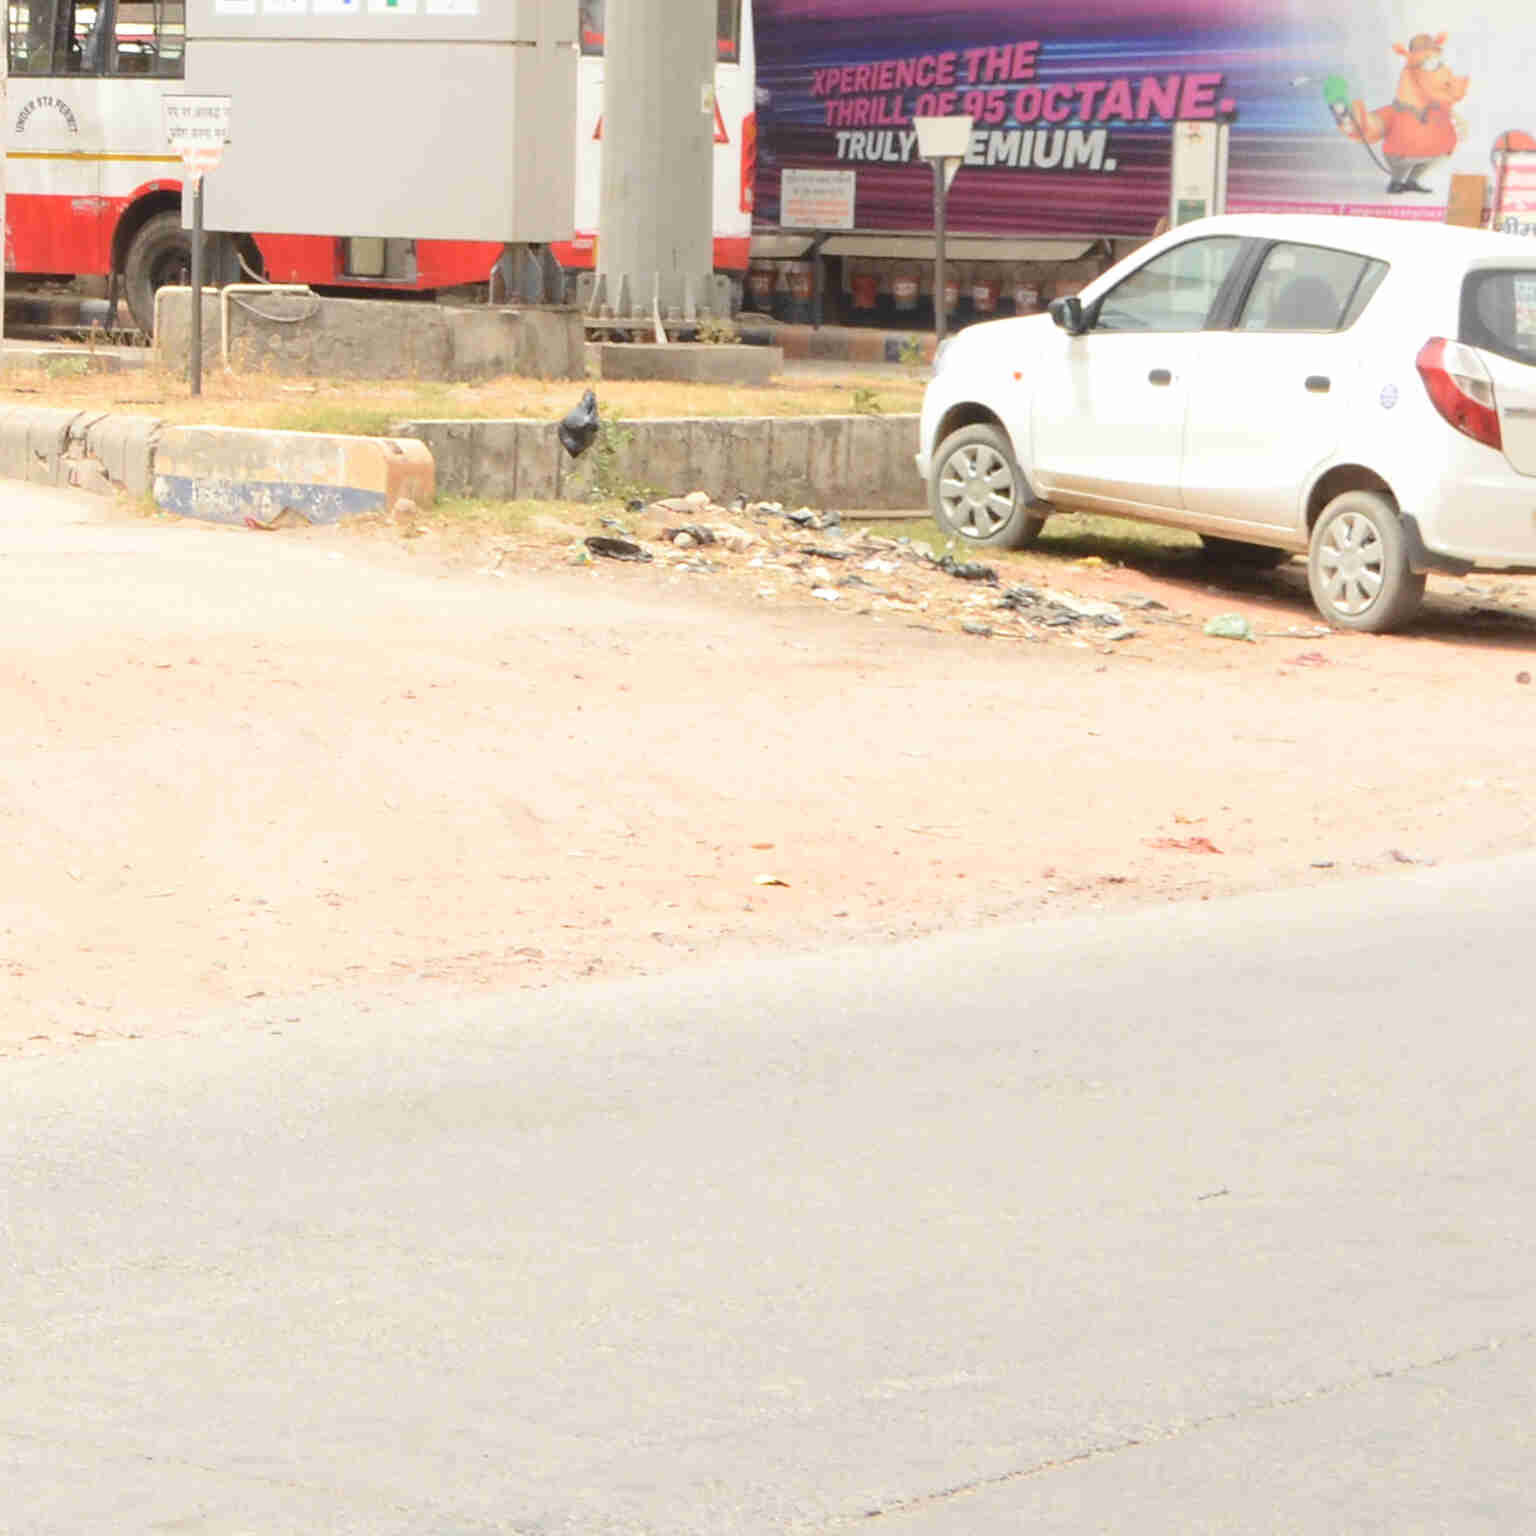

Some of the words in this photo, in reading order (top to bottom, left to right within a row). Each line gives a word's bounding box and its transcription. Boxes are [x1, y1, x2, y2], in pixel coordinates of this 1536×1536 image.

[810, 51, 958, 95] XPERIENCE
[965, 41, 1040, 82] THE
[825, 94, 909, 125] THRILL
[963, 88, 1006, 124] 95
[835, 130, 918, 162] TRULY
[962, 128, 1118, 171] EMIUM.
